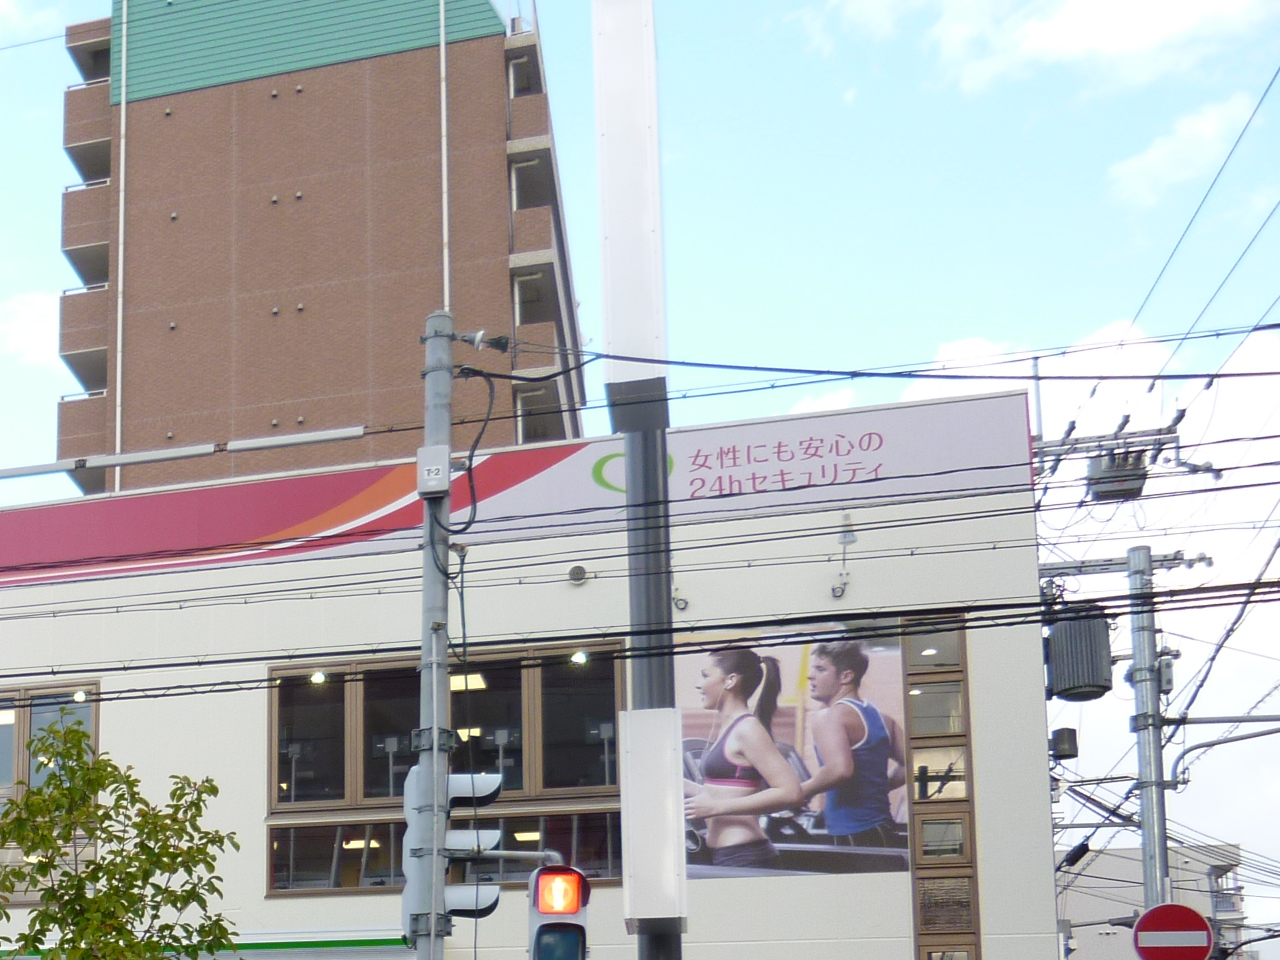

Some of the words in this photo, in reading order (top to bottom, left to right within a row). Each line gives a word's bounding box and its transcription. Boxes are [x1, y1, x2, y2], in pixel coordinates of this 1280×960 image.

[688, 432, 883, 472] 女性にも安心の
[689, 461, 883, 498] 24hセキュリティ
